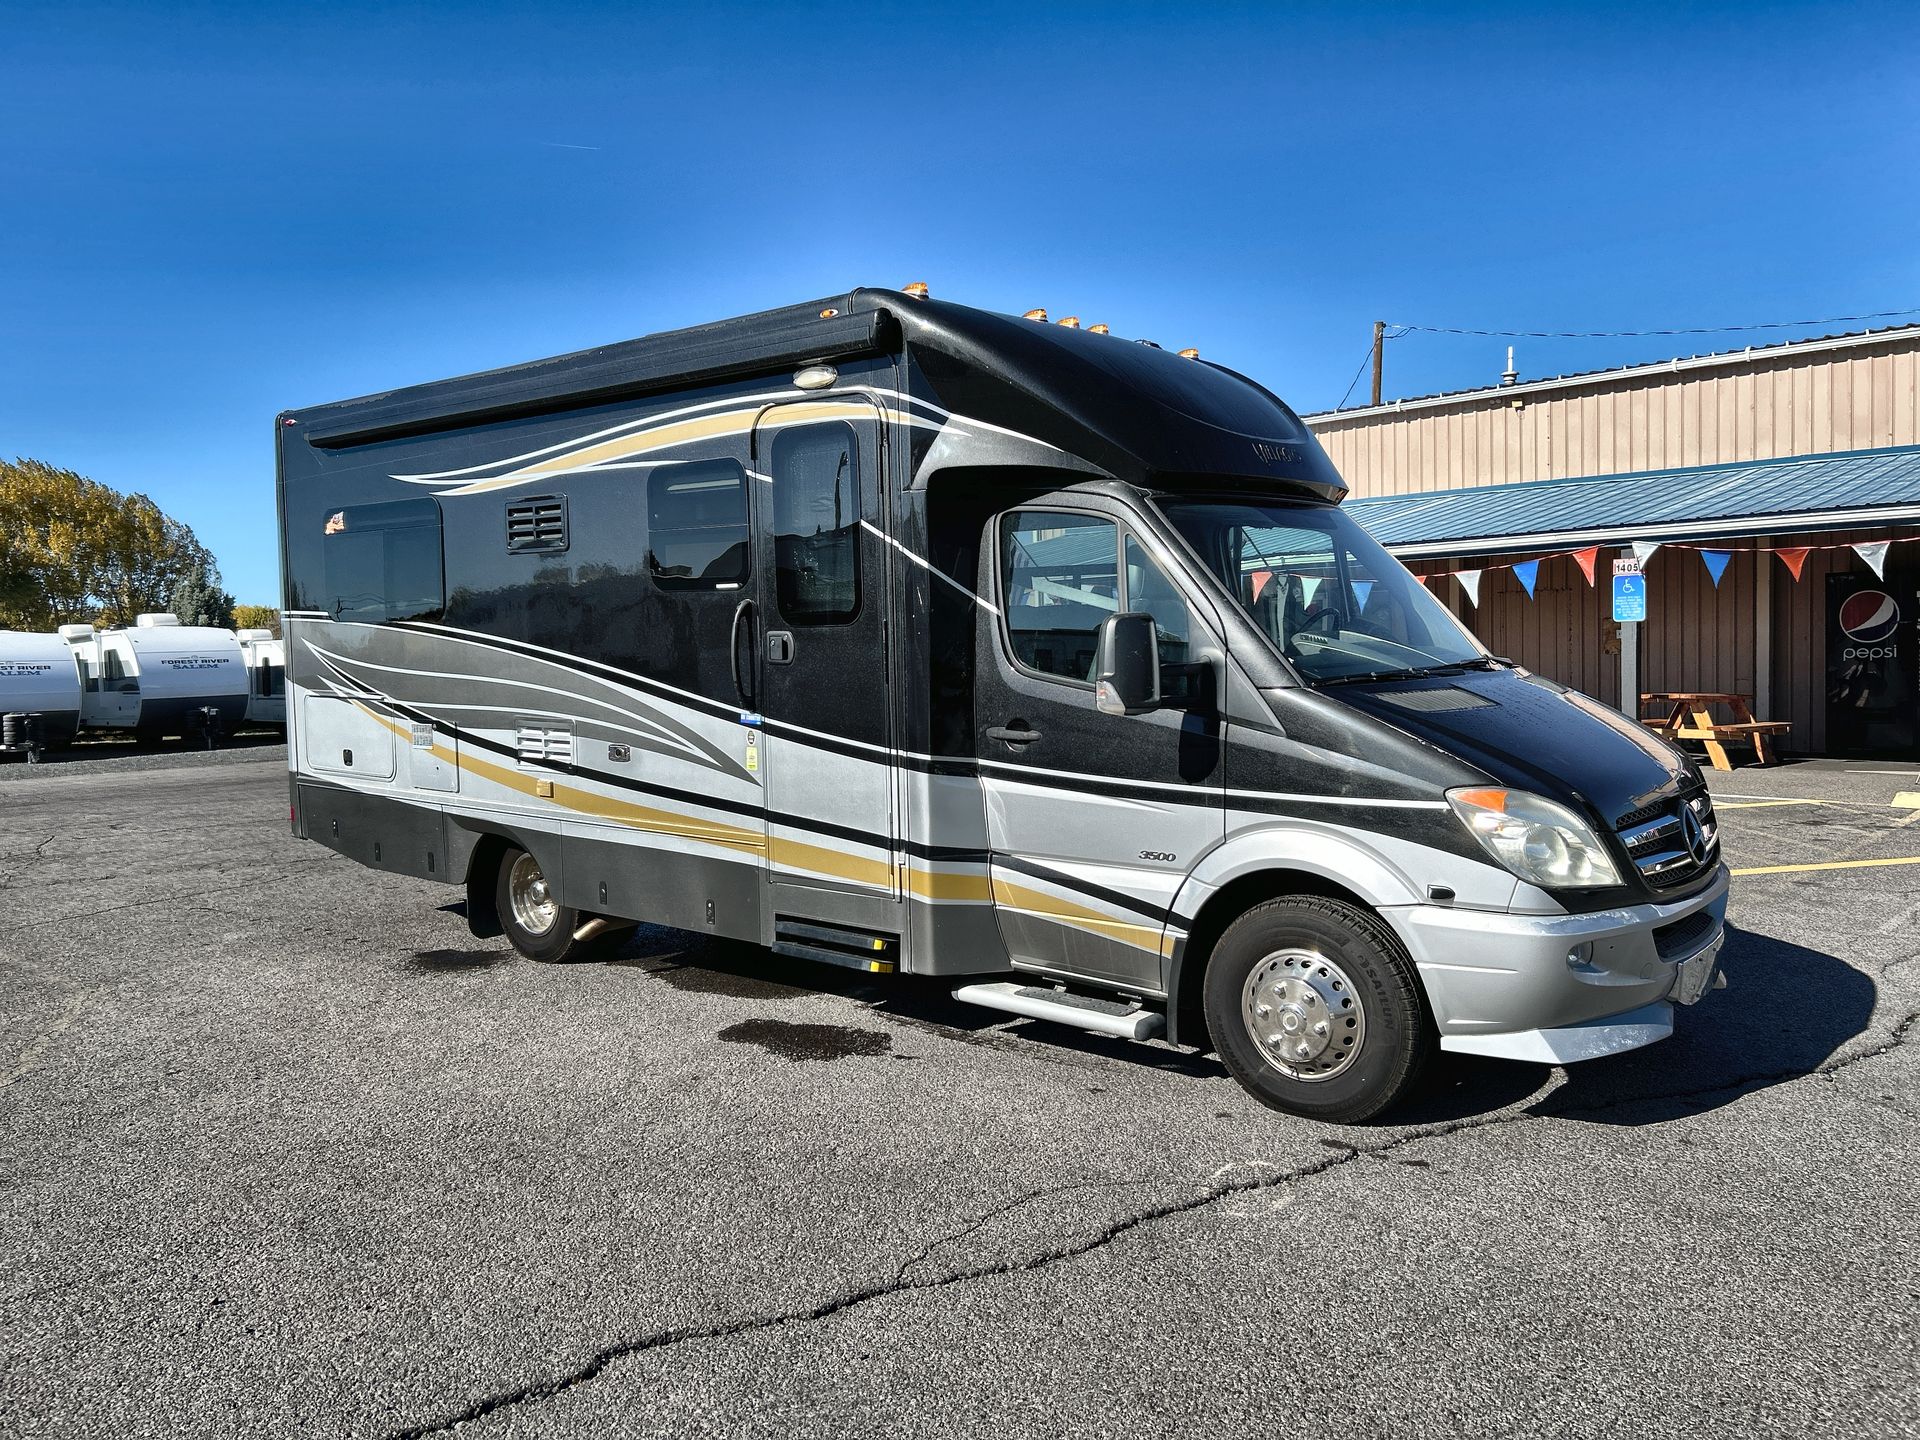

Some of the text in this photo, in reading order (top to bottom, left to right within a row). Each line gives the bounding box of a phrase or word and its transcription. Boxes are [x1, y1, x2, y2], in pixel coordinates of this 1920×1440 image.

[1616, 563, 1639, 572] 1405
[1843, 644, 1897, 661] pepsi
[1138, 850, 1177, 862] 3500
